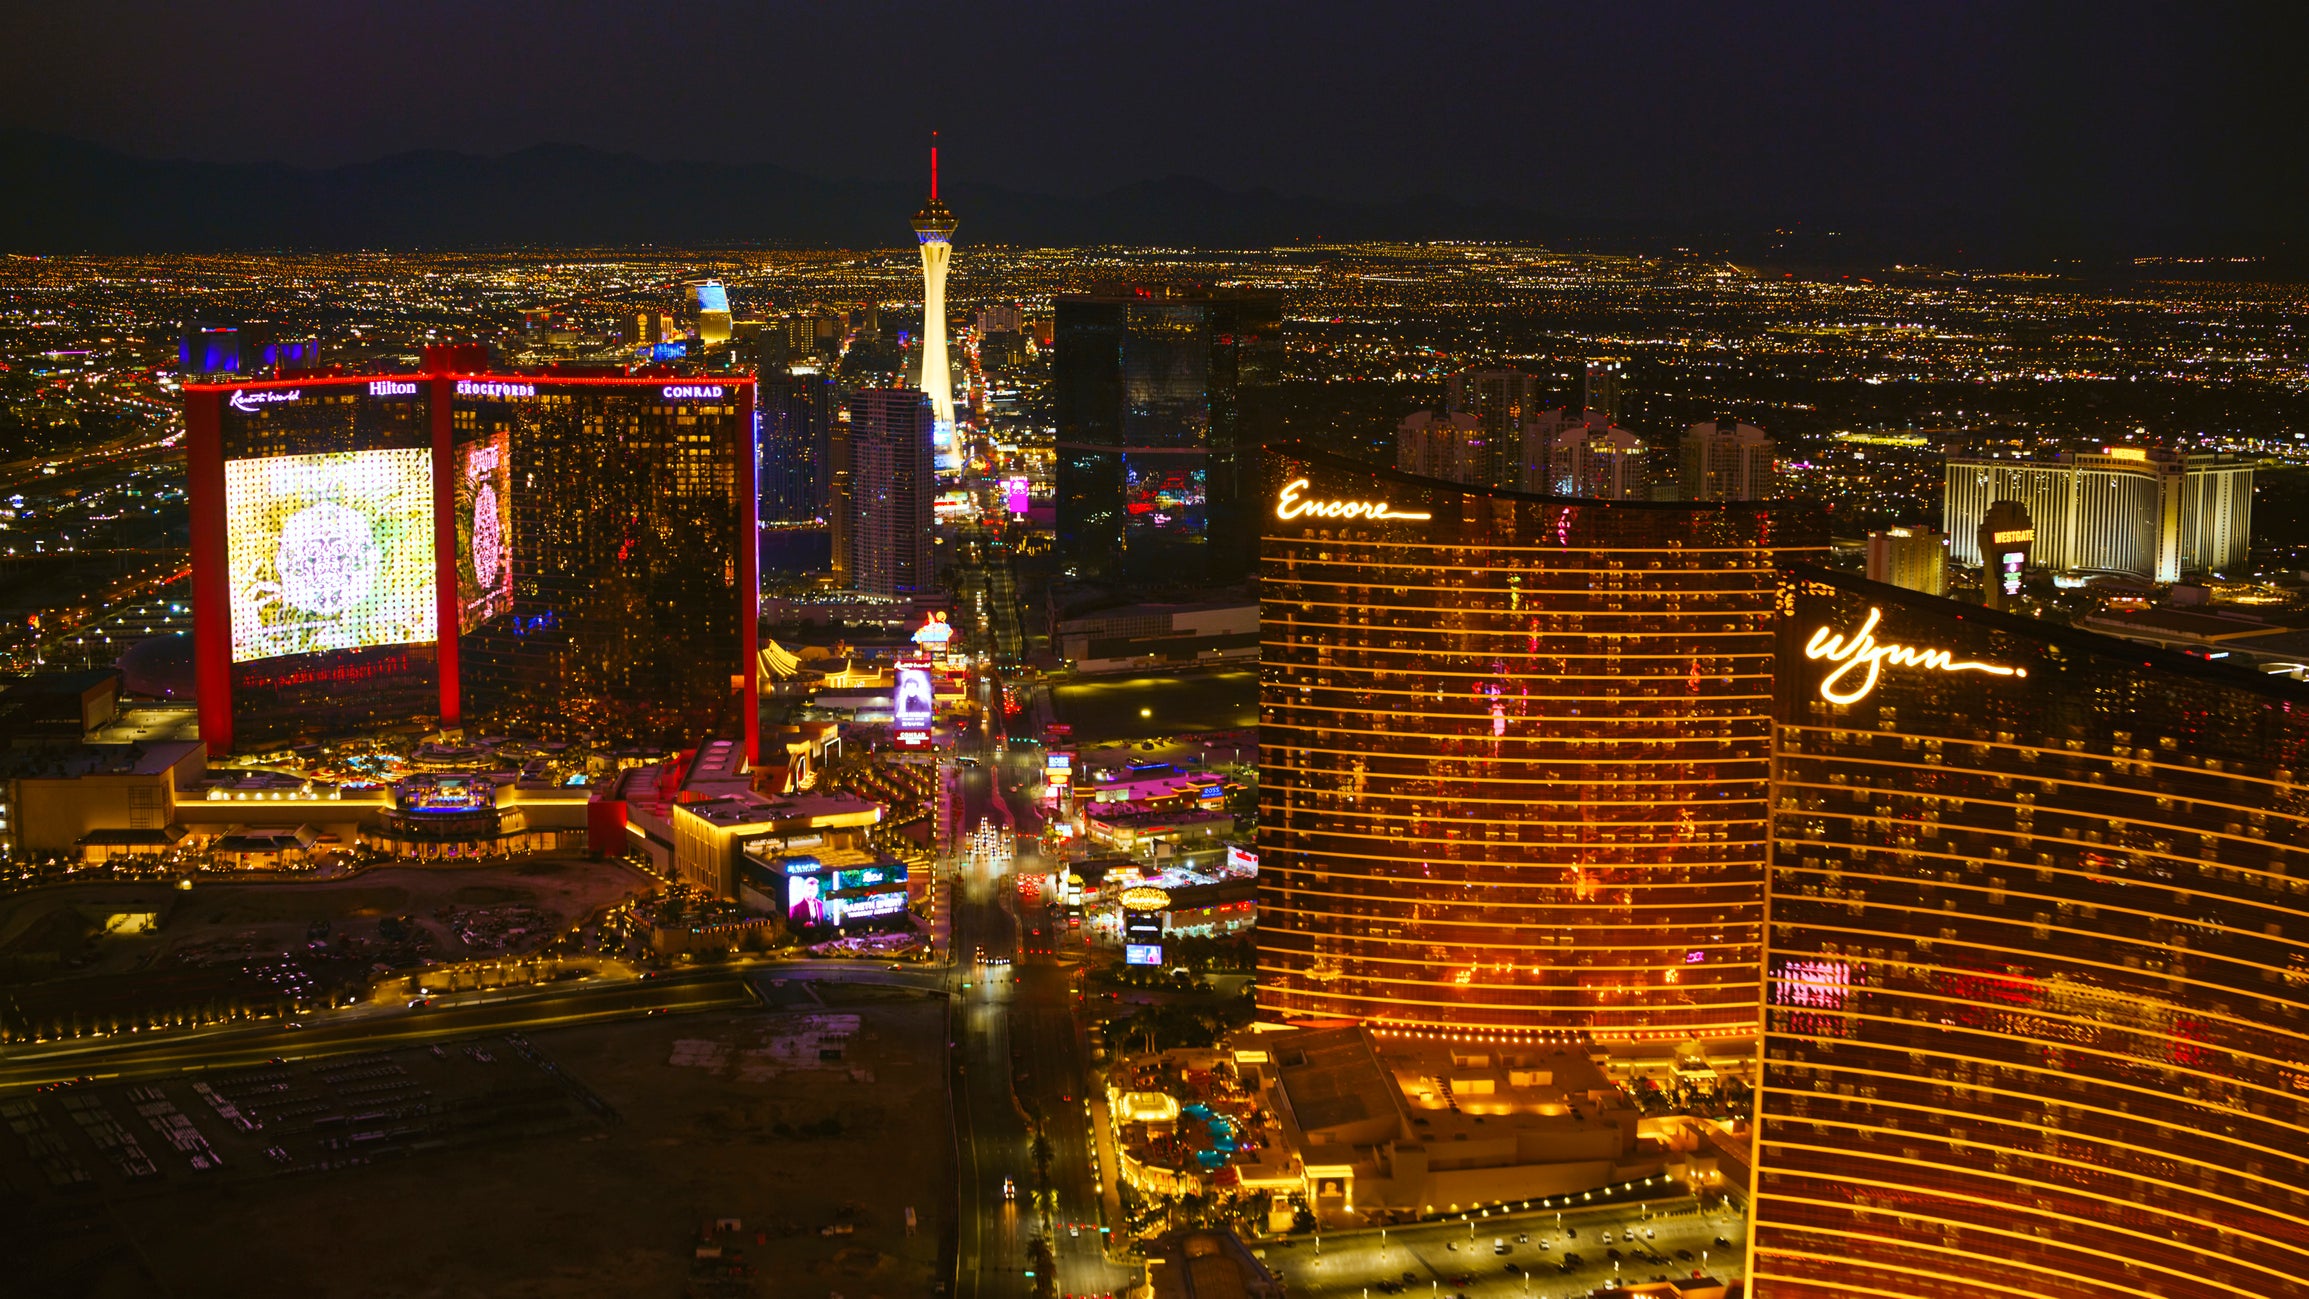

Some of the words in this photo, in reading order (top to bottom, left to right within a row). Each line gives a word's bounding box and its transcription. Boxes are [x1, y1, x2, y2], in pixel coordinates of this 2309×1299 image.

[369, 381, 417, 396] Hilton
[457, 383, 535, 397] CROCKFORDS
[662, 386, 723, 398] CONRAD
[1276, 479, 1432, 520] Encore
[1994, 529, 2035, 544] WESTGATE
